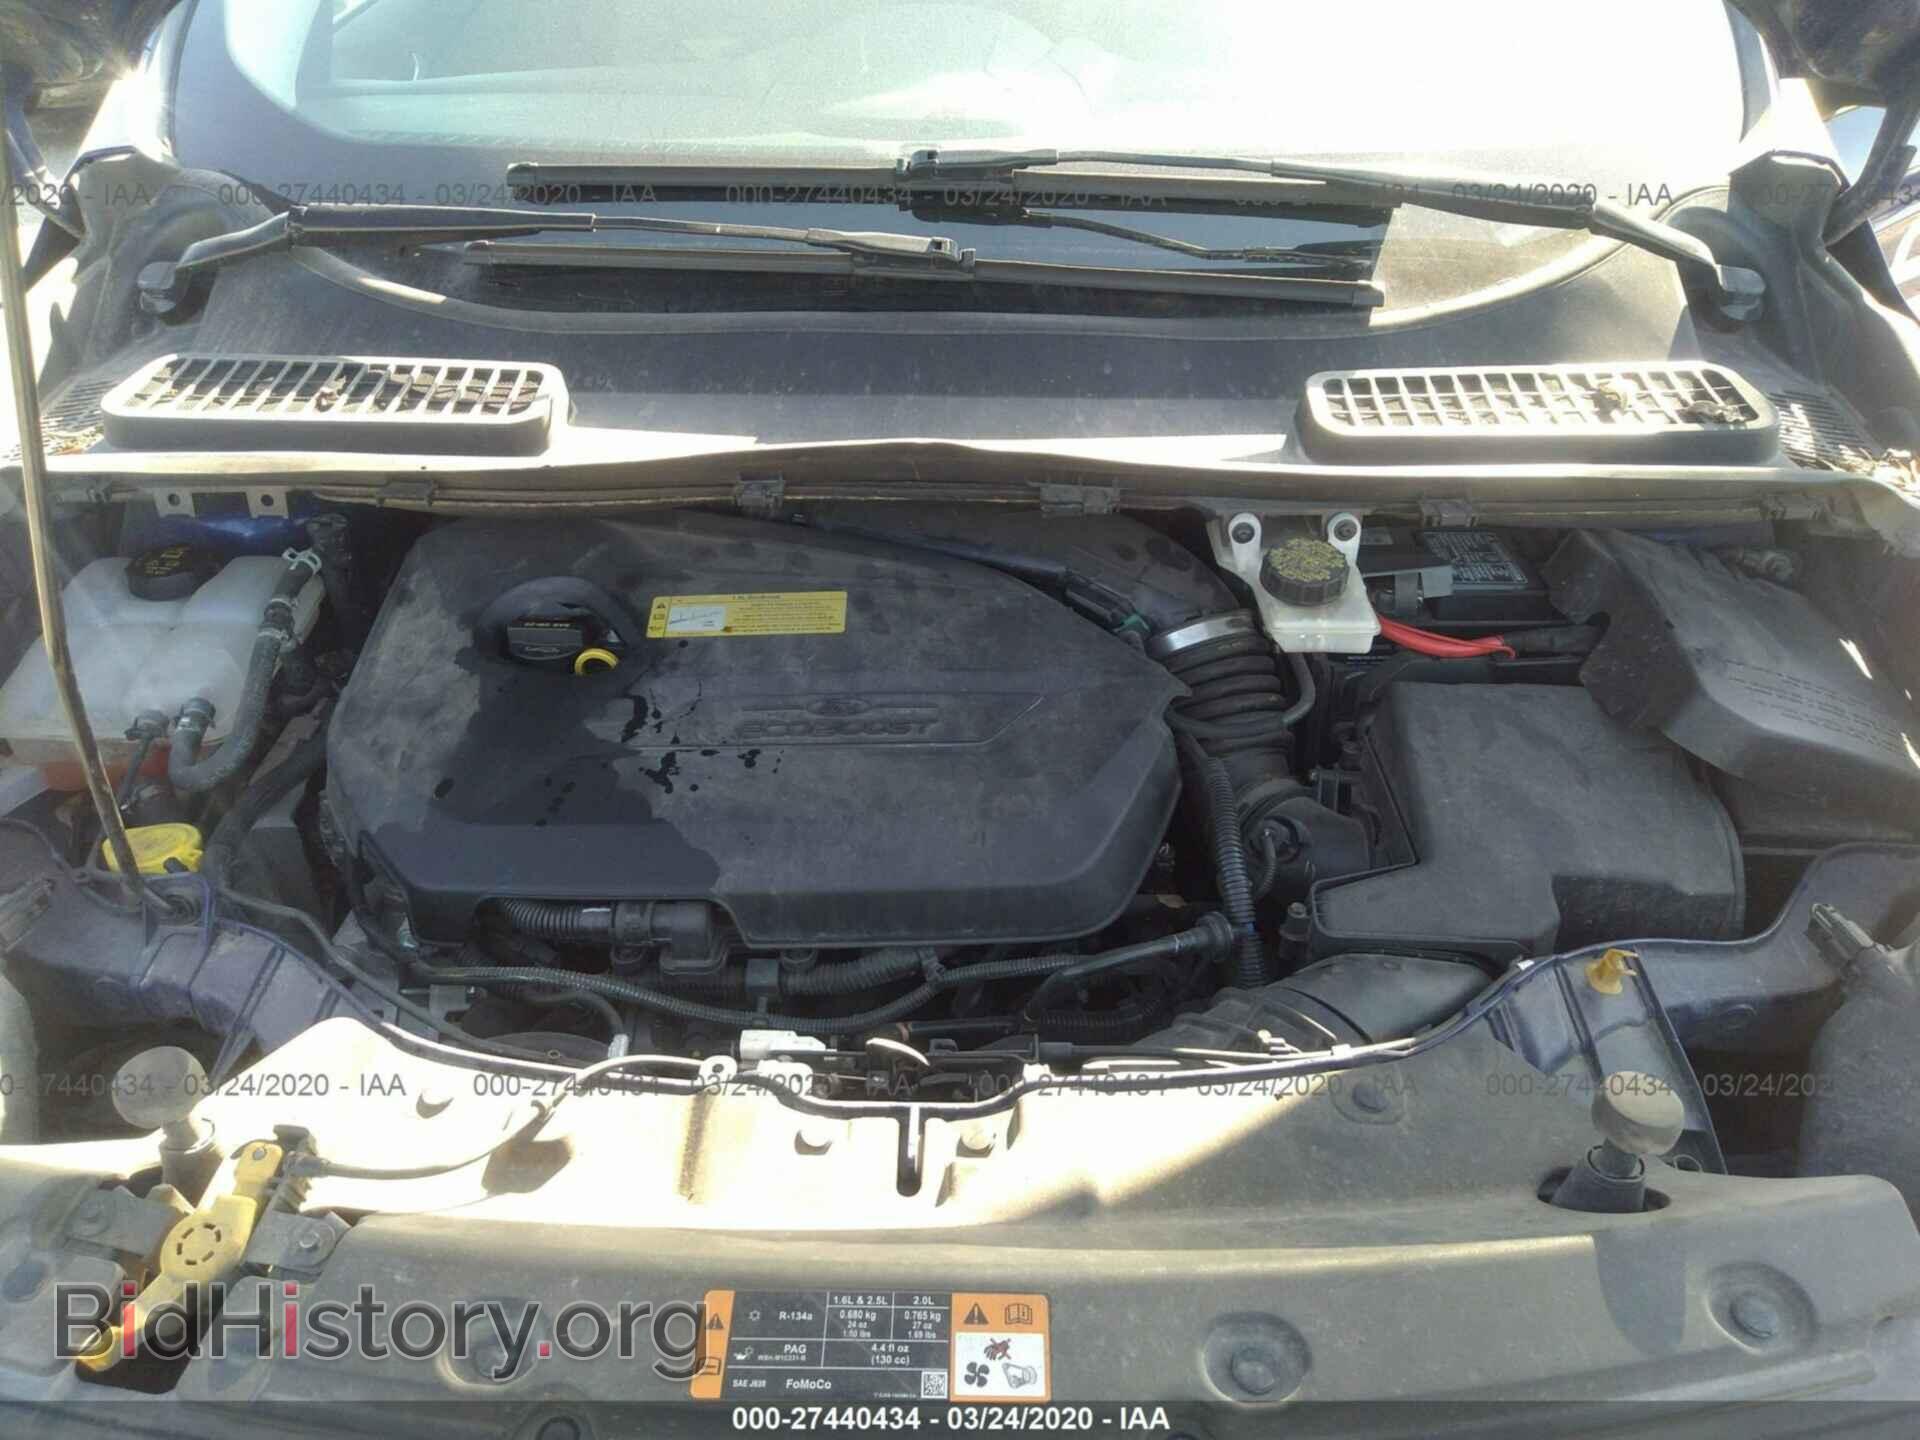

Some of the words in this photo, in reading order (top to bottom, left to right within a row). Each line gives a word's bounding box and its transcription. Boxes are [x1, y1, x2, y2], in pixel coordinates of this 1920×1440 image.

[912, 1295, 935, 1305] 2.0L
[778, 1310, 814, 1321] R-134a
[865, 1309, 877, 1322] kg
[929, 1310, 942, 1323] kg
[783, 1343, 807, 1354] PAG
[897, 1344, 910, 1353] oz
[785, 1378, 832, 1390] FoMoCo
